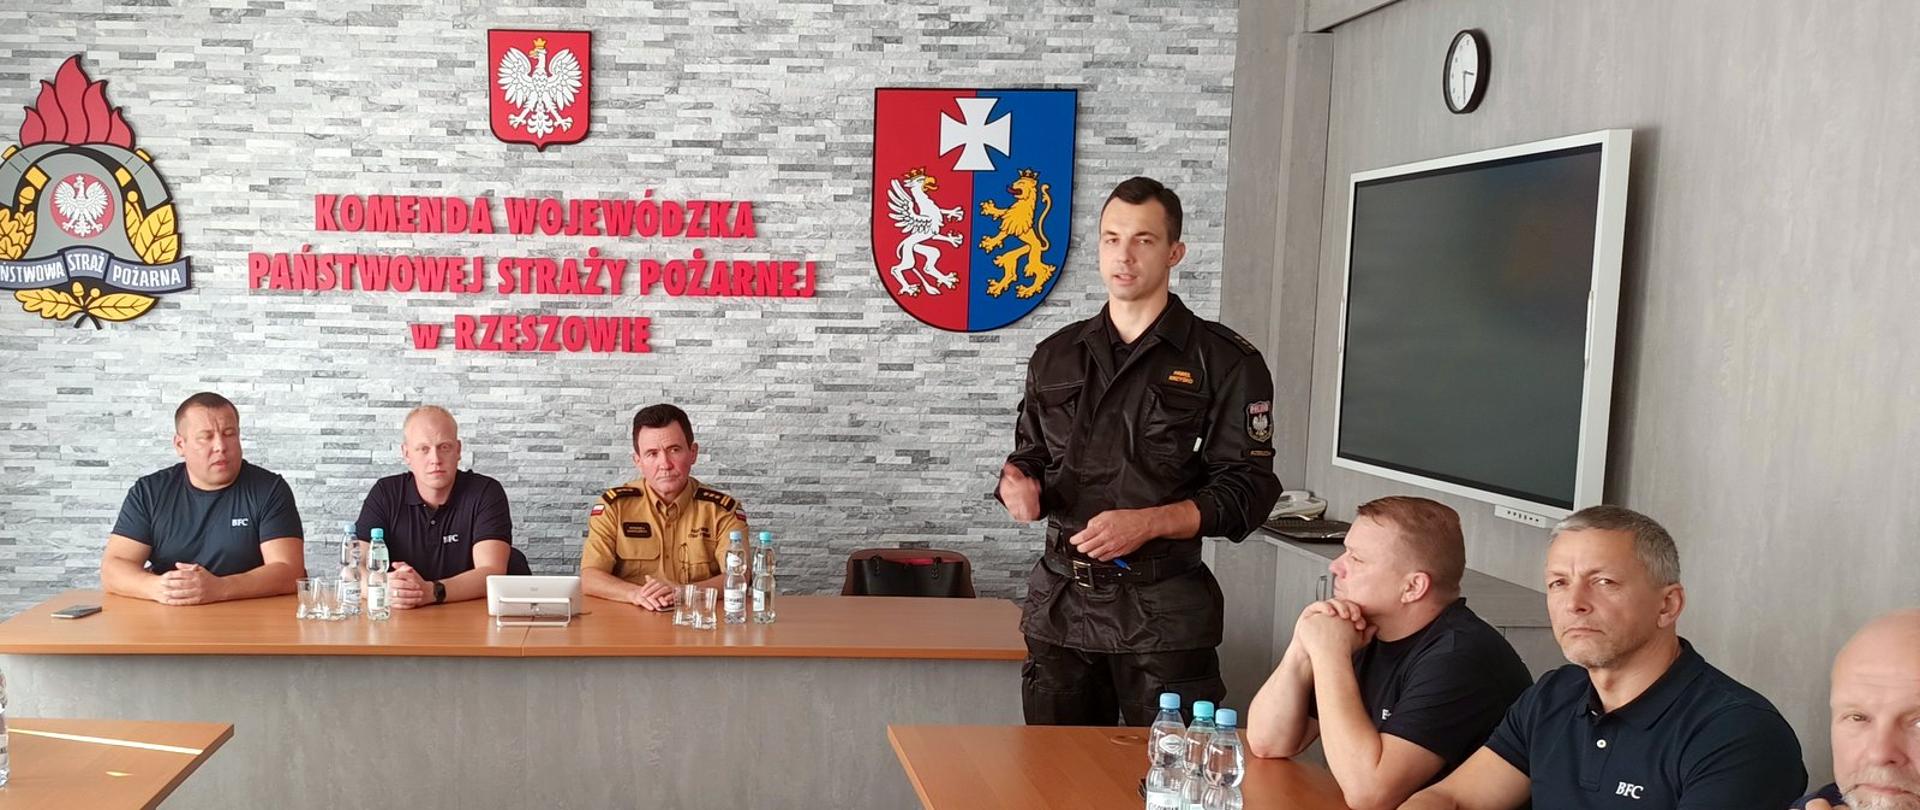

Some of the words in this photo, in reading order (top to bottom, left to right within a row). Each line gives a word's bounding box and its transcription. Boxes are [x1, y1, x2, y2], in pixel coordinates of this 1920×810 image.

[315, 194, 494, 234] KOMENDA
[504, 189, 757, 239] WOJEWÓDZKA
[67, 252, 106, 273] STRAŻ
[112, 264, 182, 288] POŻARNA
[248, 244, 485, 294] PAŃSTWOWEJ
[498, 247, 629, 296] STRAŻY
[639, 248, 818, 299] POŻARNEJ
[411, 323, 443, 350] w
[454, 314, 653, 354] RZESZOWIE
[1615, 781, 1644, 800] BFC
